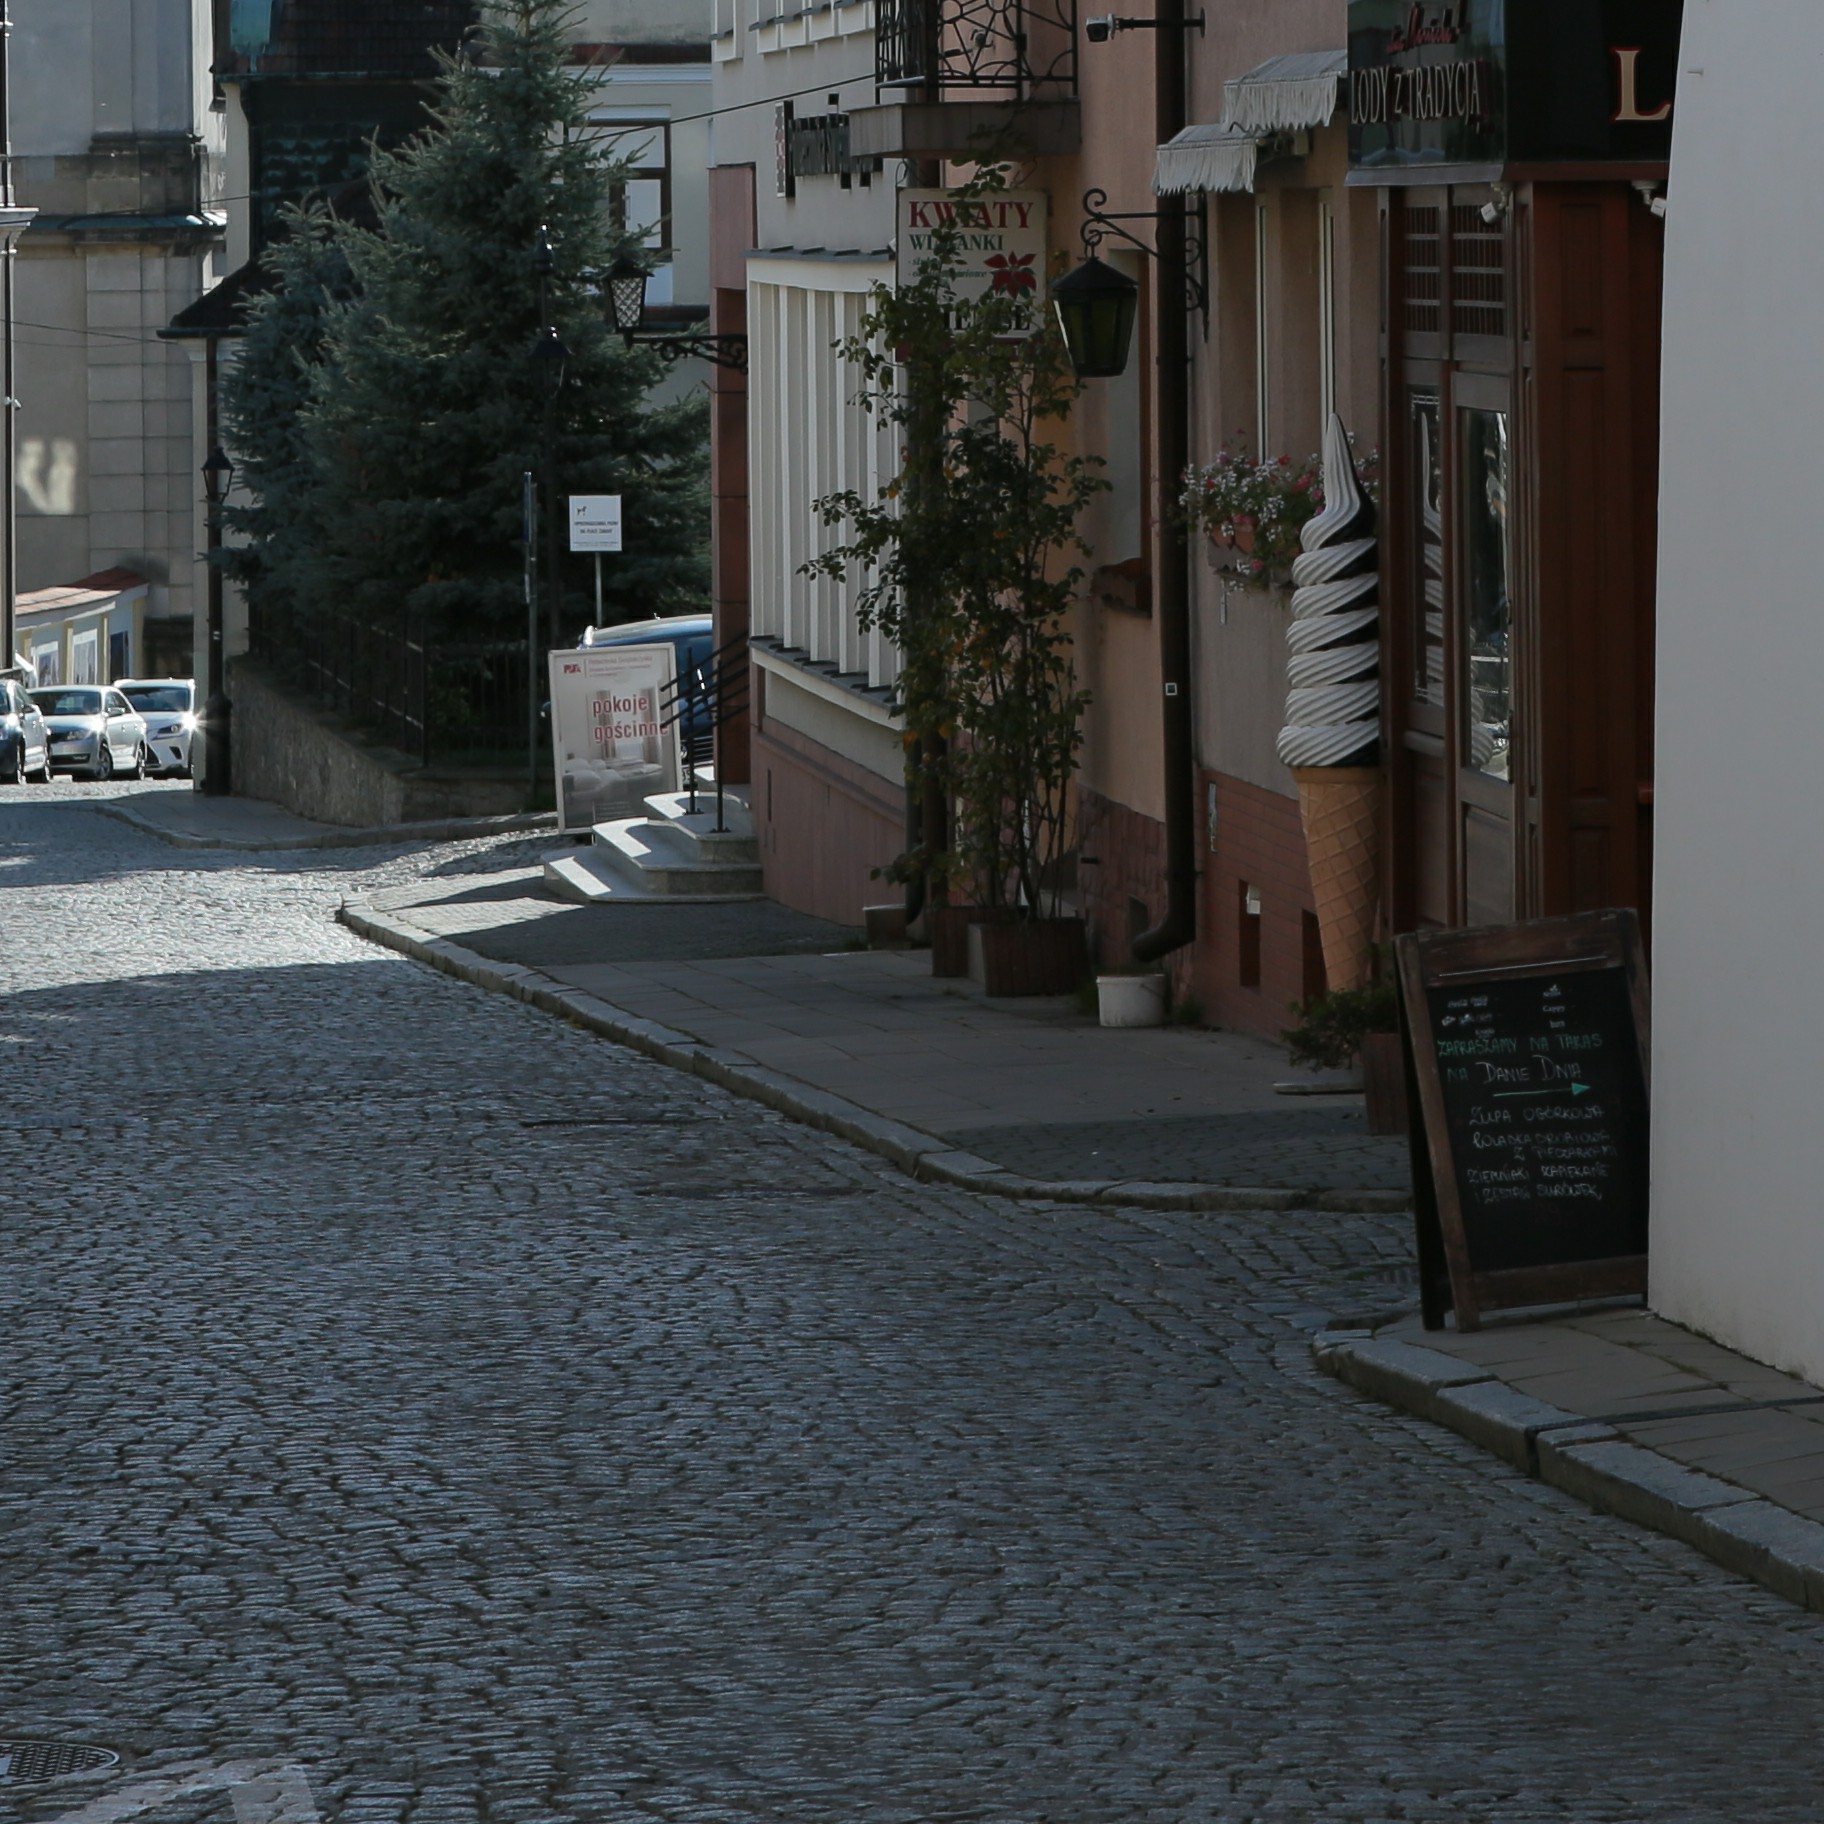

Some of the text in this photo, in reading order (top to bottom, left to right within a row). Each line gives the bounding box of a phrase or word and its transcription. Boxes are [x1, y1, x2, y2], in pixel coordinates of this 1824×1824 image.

[1350, 65, 1390, 125] LODY
[1406, 60, 1481, 134] TRADYCJĄ
[1609, 46, 1673, 124] L
[908, 200, 1034, 228] KWATY
[908, 233, 1004, 252] WIANKI
[592, 694, 648, 720] pokoje
[594, 720, 670, 745] gościnne
[1436, 1037, 1518, 1057] ZAPRASZAMY
[1529, 1036, 1550, 1052] NA
[1446, 1053, 1582, 1085] NA DANIE DNIA
[1468, 1105, 1513, 1127] ZUPA
